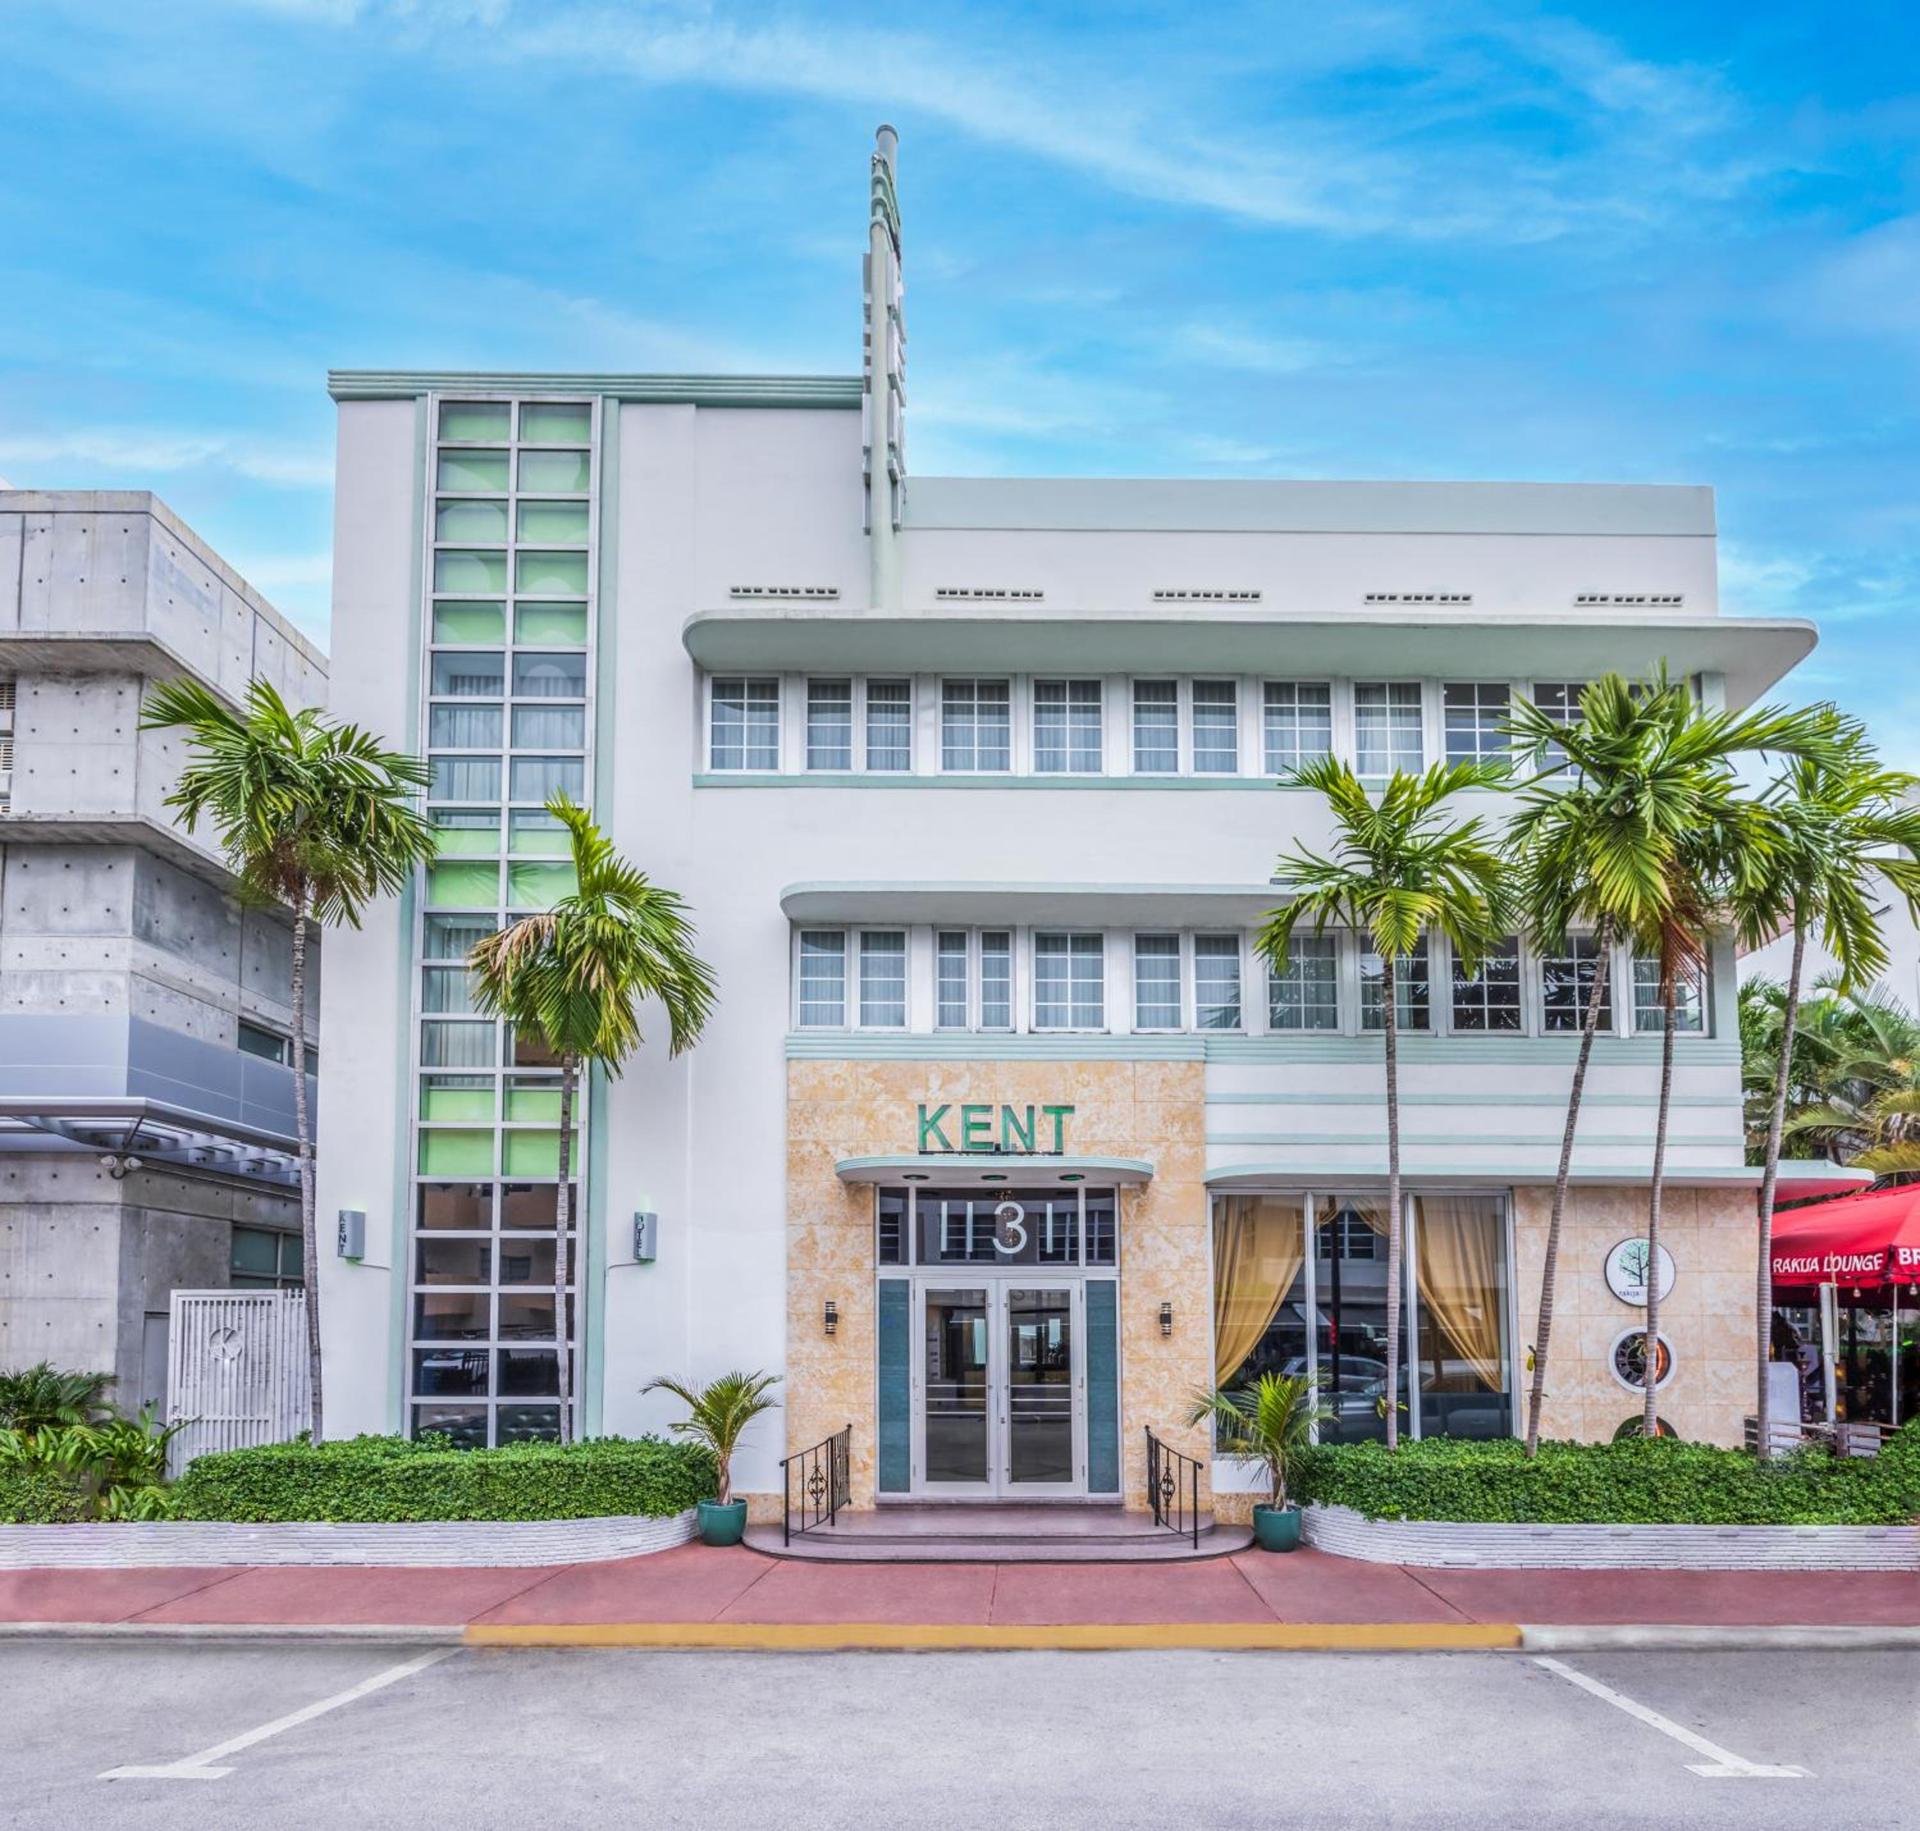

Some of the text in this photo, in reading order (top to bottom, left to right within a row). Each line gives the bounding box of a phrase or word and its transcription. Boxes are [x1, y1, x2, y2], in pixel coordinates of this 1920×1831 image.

[917, 1104, 1075, 1151] KENT
[940, 1200, 1054, 1255] 1131
[1823, 1253, 1883, 1272] LOUNGE
